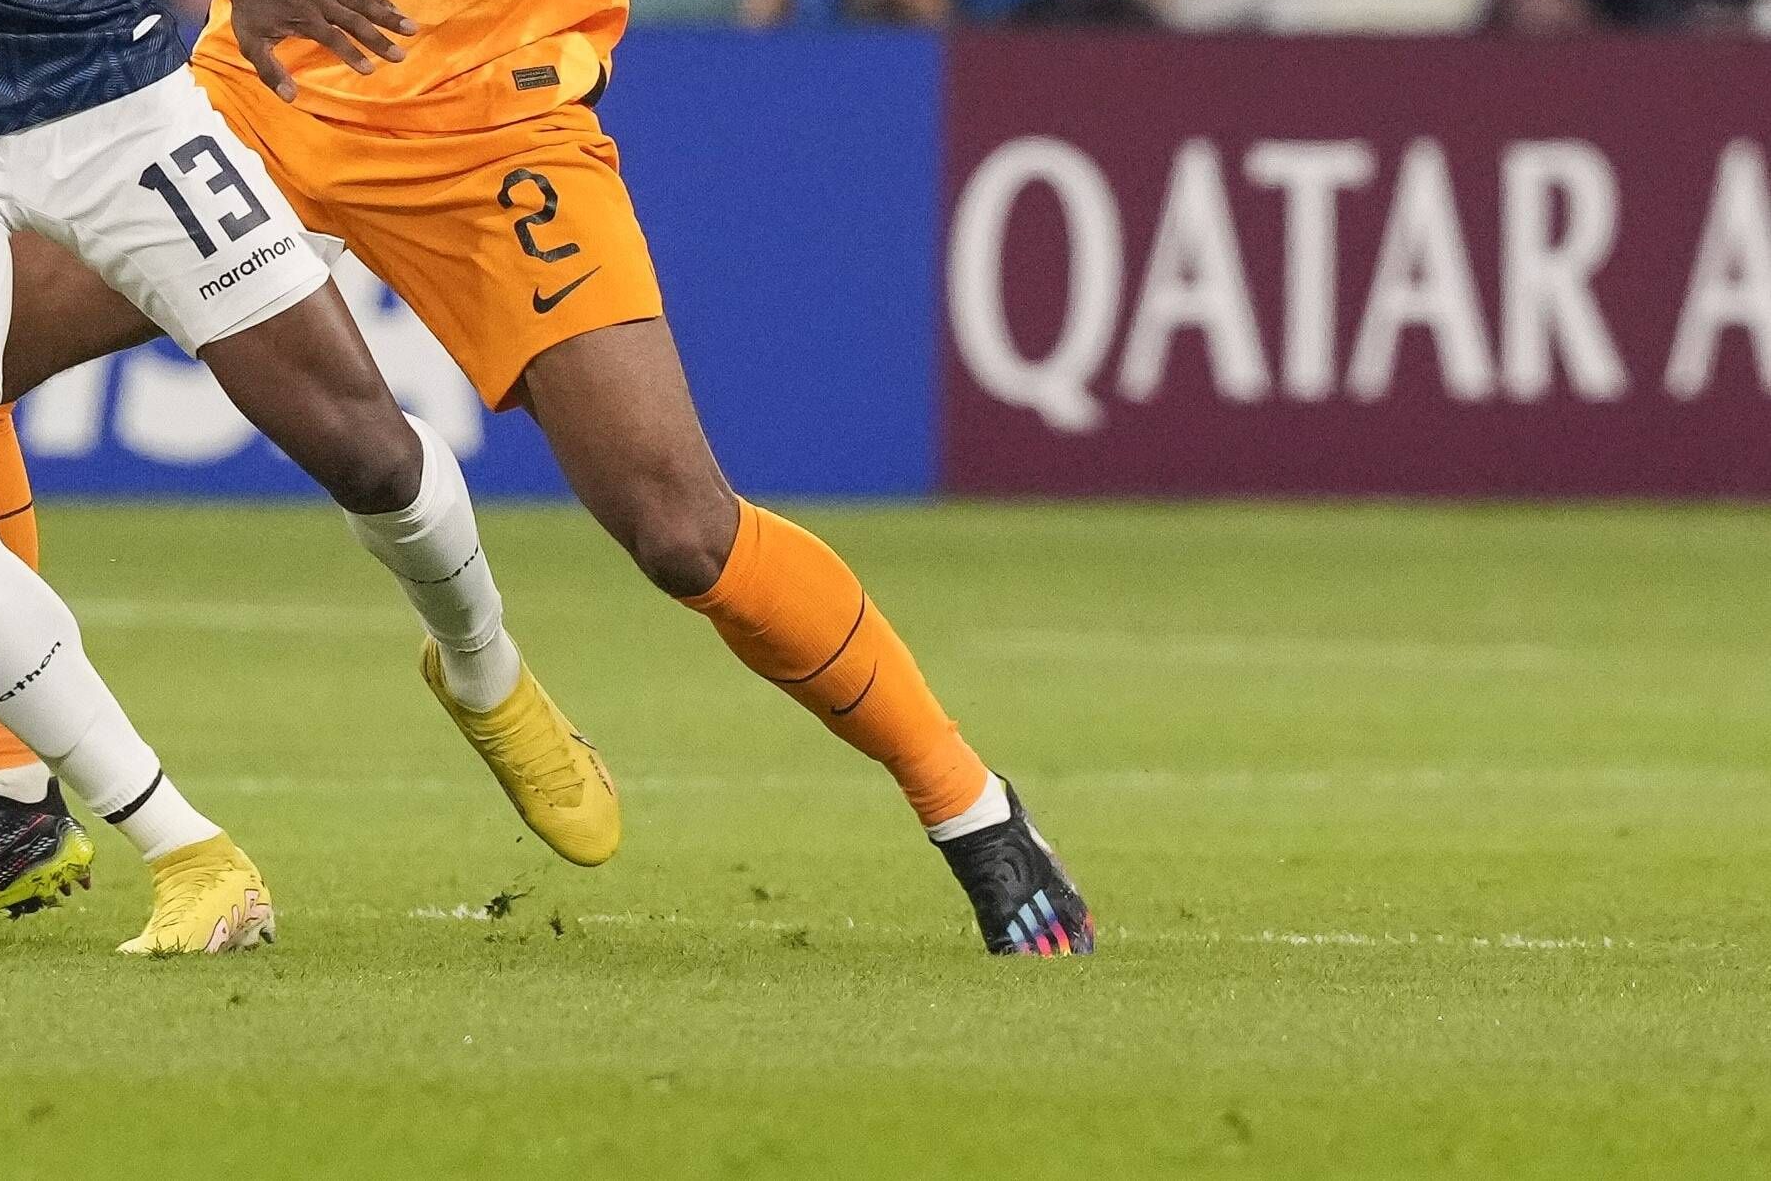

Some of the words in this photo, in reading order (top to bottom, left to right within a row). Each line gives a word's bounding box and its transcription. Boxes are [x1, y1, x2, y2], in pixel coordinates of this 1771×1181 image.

[138, 134, 271, 260] 13
[497, 168, 579, 263] 2
[198, 235, 296, 301] marathon
[946, 134, 1630, 435] QATAR
